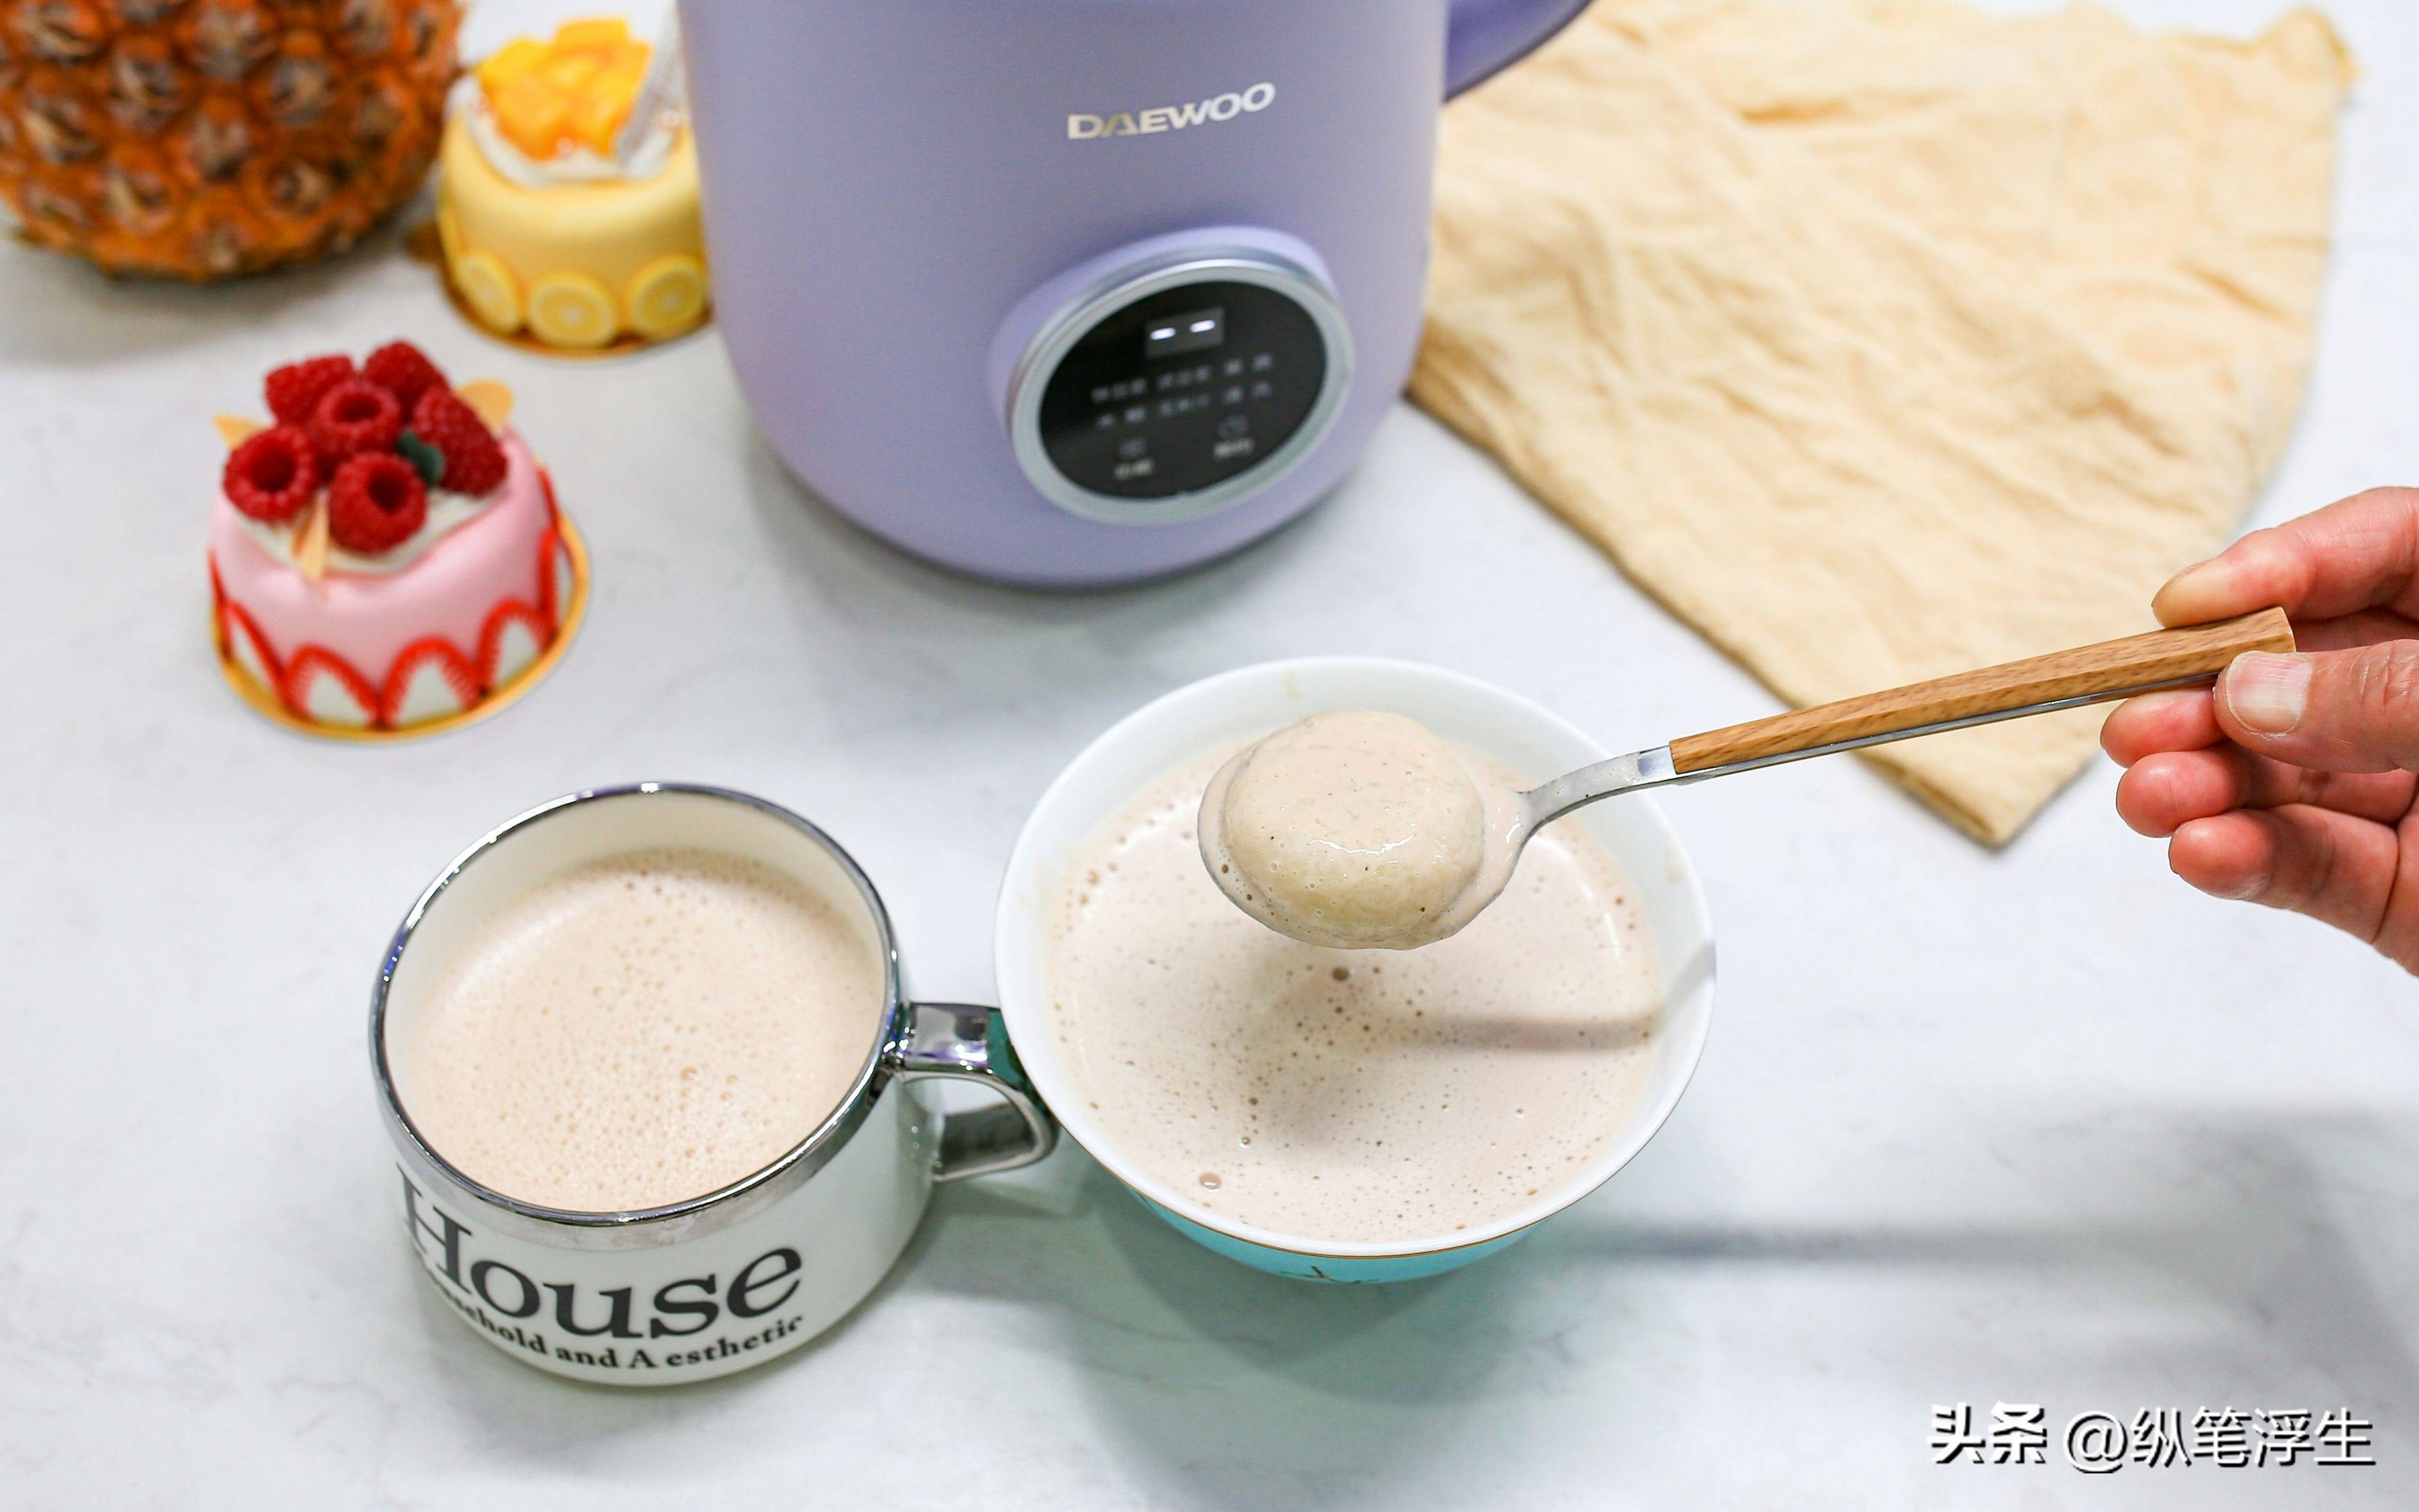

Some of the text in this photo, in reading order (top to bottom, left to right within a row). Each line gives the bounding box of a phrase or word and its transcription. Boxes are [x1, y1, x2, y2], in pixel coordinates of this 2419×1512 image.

[1067, 82, 1277, 140] DAEWOO
[395, 1161, 803, 1340] House
[555, 1345, 619, 1369] and
